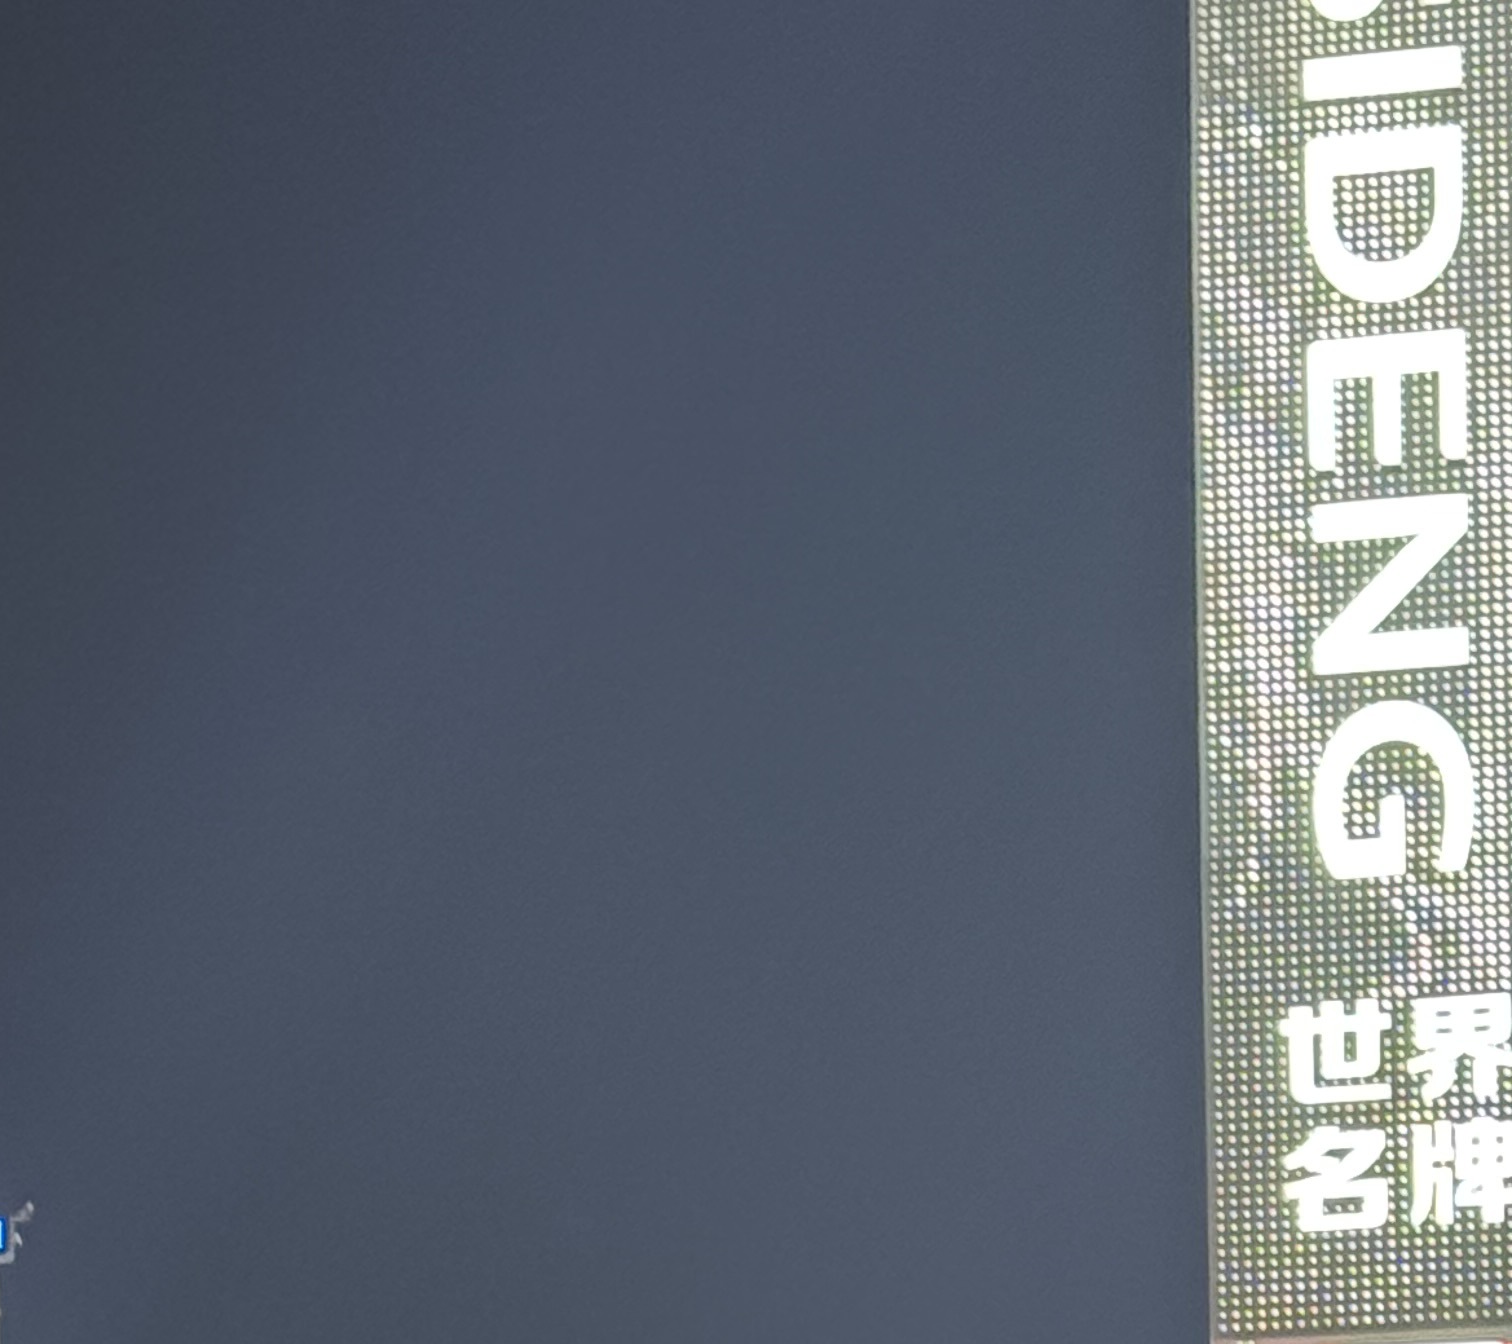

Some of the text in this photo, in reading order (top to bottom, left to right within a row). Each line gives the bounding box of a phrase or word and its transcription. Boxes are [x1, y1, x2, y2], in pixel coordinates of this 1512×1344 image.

[1301, 0, 1478, 880] IDENG
[1278, 992, 1512, 1106] 世界
[1284, 1116, 1512, 1233] 名牌
